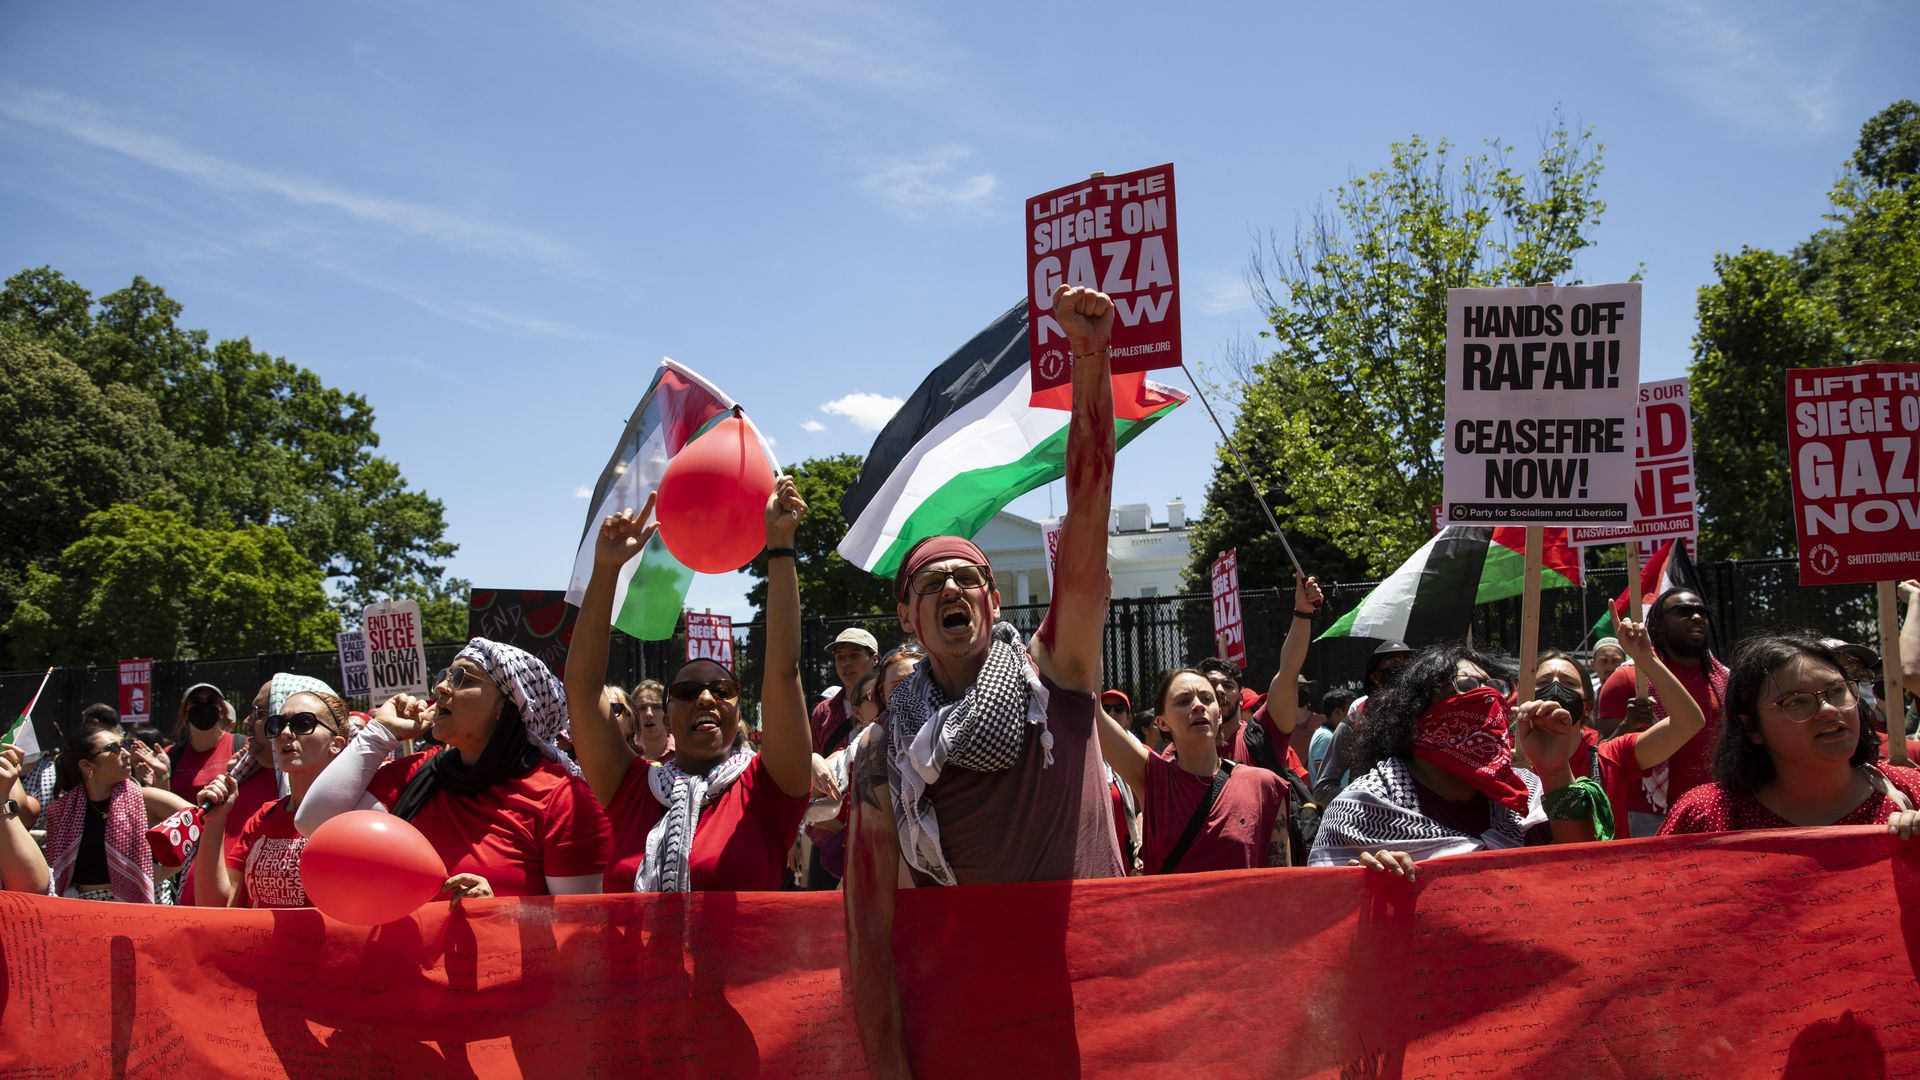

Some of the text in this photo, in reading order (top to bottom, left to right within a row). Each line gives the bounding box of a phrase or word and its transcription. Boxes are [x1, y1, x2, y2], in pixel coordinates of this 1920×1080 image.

[1033, 173, 1166, 221] LIFT THE
[1033, 196, 1168, 255] SIEGE ON
[1034, 234, 1172, 312] GAZA
[1038, 290, 1174, 346] NW
[1463, 302, 1625, 338] HANDS OFF
[1462, 340, 1620, 390] RAFAH!
[1654, 384, 1683, 400] OUR
[1794, 372, 1920, 397] LIFT TH
[1796, 396, 1920, 438] SIEGE O
[1454, 418, 1624, 454] CEASEFIRE
[1485, 458, 1589, 498] NOW!
[1798, 437, 1920, 500] GAZ
[1470, 508, 1492, 519] Party
[1495, 508, 1508, 517] for
[1510, 508, 1553, 517] Socialism
[1556, 509, 1572, 517] and
[1575, 508, 1623, 517] Liberation
[1576, 519, 1689, 539] ANSWERCOALITION.ORG
[1848, 551, 1920, 565] SHUTITDOWN4PALE
[368, 612, 414, 631] END THE
[480, 602, 522, 638] END
[688, 616, 729, 626] LIFT THE
[1213, 590, 1241, 631] GAZA
[369, 627, 416, 651] SIEGE
[688, 624, 730, 640] SIEGE ON
[342, 640, 366, 651] PALES
[344, 650, 364, 663] END
[372, 648, 420, 666] ON GAZA
[688, 639, 732, 662] GAZA
[347, 672, 368, 690] NO
[372, 662, 421, 688] NOW!
[260, 850, 300, 859] FIGHT LIK
[255, 877, 303, 889] HEROES
[257, 888, 305, 898] FIGHT LIKE
[260, 897, 304, 905] PALESTINIANS
